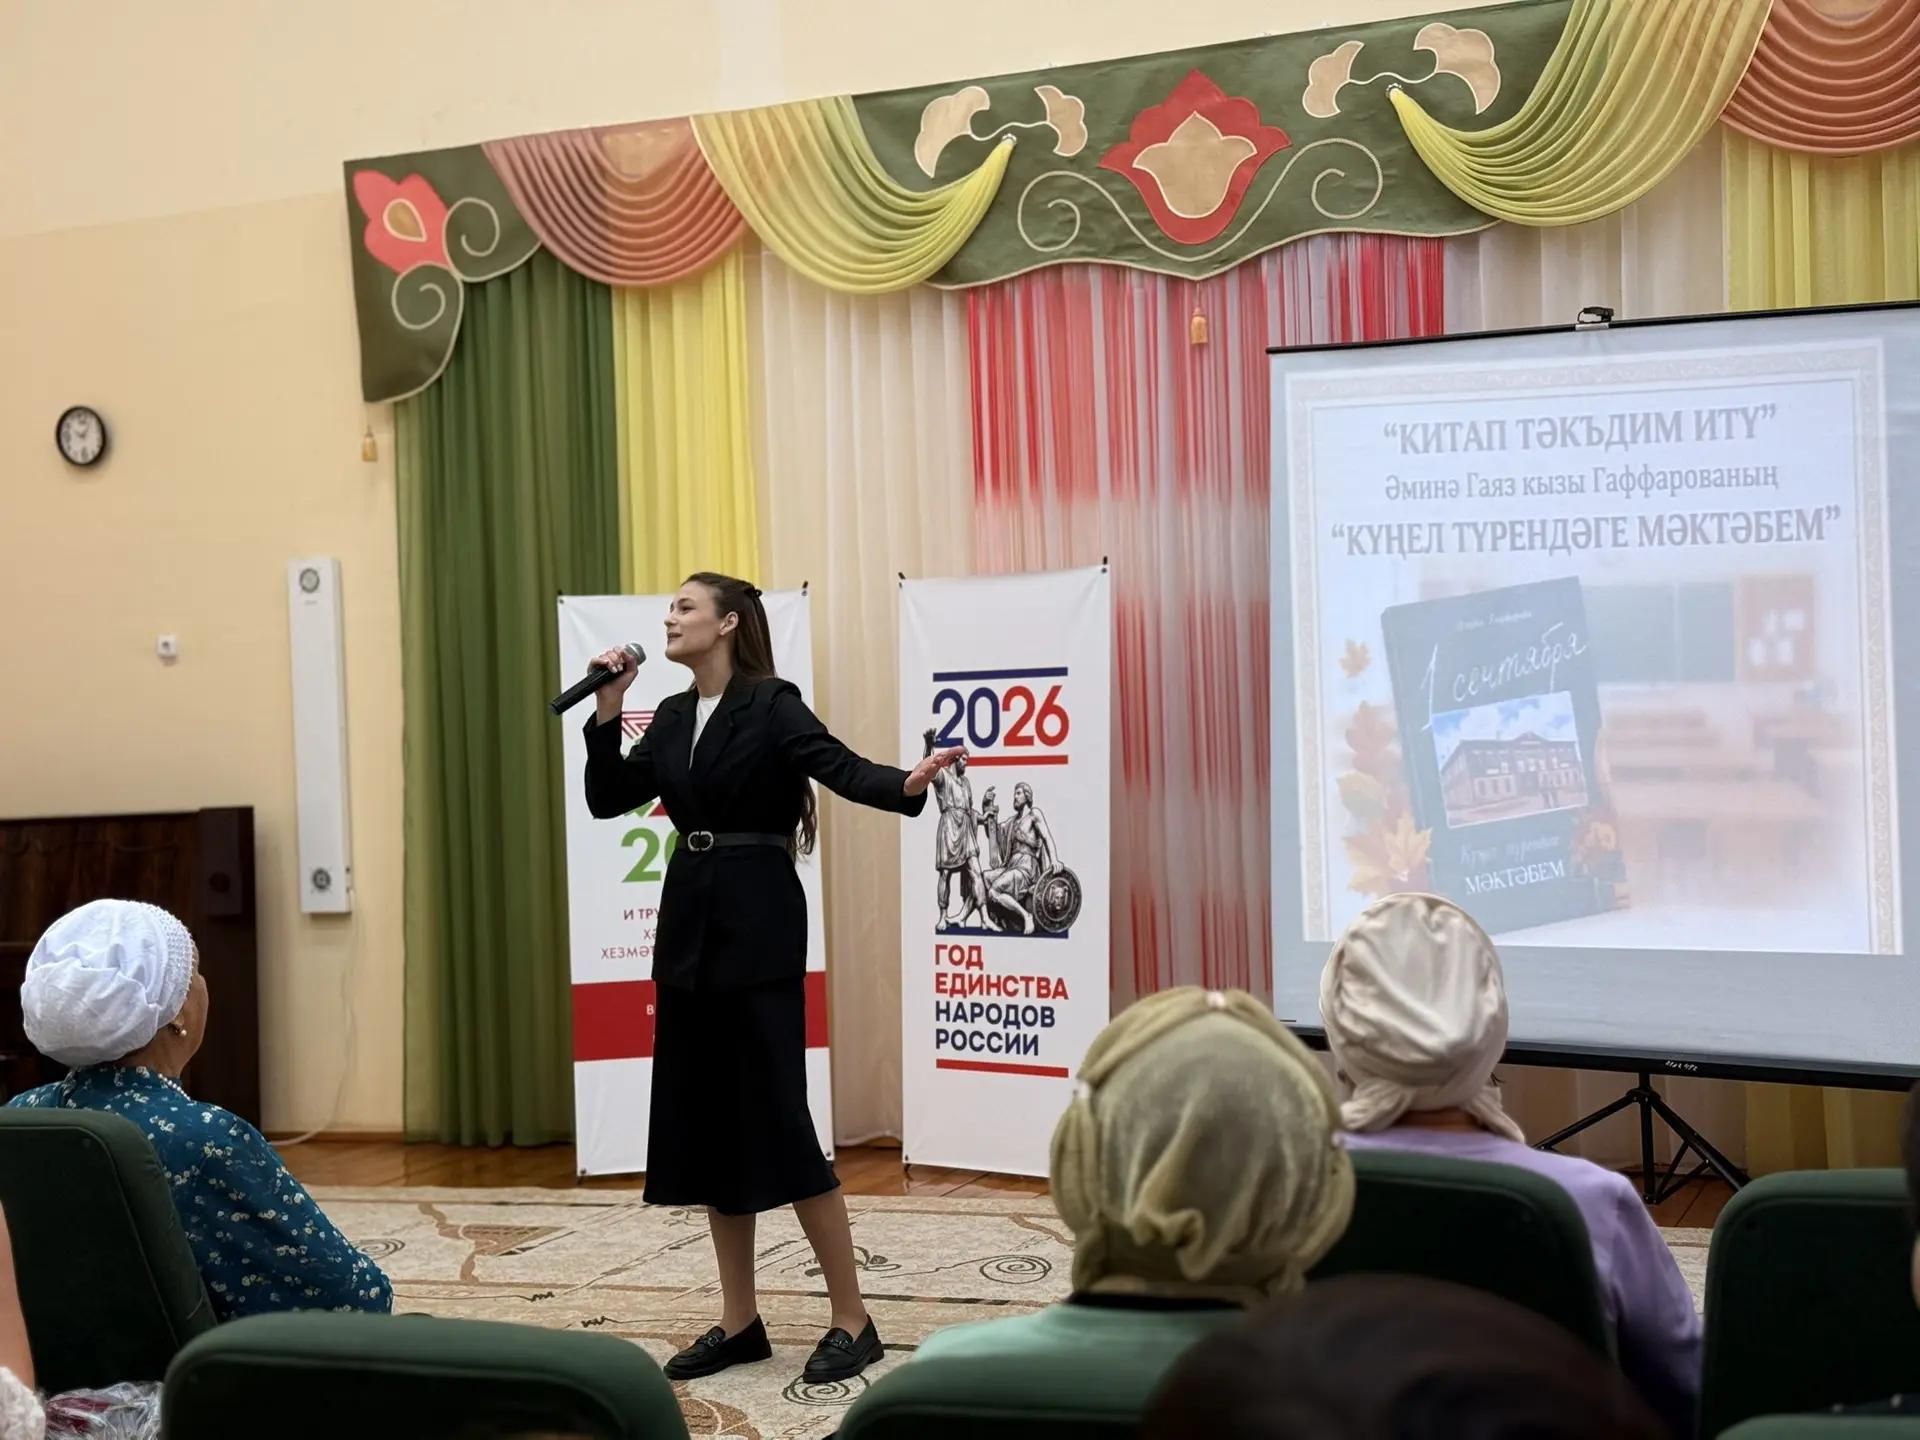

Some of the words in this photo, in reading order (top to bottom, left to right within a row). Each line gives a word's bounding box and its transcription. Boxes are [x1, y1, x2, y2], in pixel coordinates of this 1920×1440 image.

[1384, 419, 1507, 455] “КИТАП
[1515, 410, 1683, 452] ТӘКЪДИМ
[1694, 402, 1777, 442] ИТҮ”
[1385, 474, 1460, 501] Әминә
[1466, 471, 1517, 498] Гаяз
[1522, 473, 1586, 497] кызы
[1592, 463, 1779, 499] Гаффарованың
[1331, 521, 1445, 558] “КҮҢЕЛ
[1451, 515, 1629, 556] ТҮРЕНДӘГЕ
[1638, 504, 1842, 547] МӘКТӘБЕМ”
[932, 685, 1070, 748] 2026
[1465, 858, 1566, 896] МӘКТӘБЕМ
[623, 908, 635, 921] И
[935, 944, 984, 971] ГОД
[935, 972, 1070, 1000] ЕДИНСТВА
[935, 1000, 1056, 1030] НАРОДОВ
[935, 1028, 1039, 1056] РОССИИ
